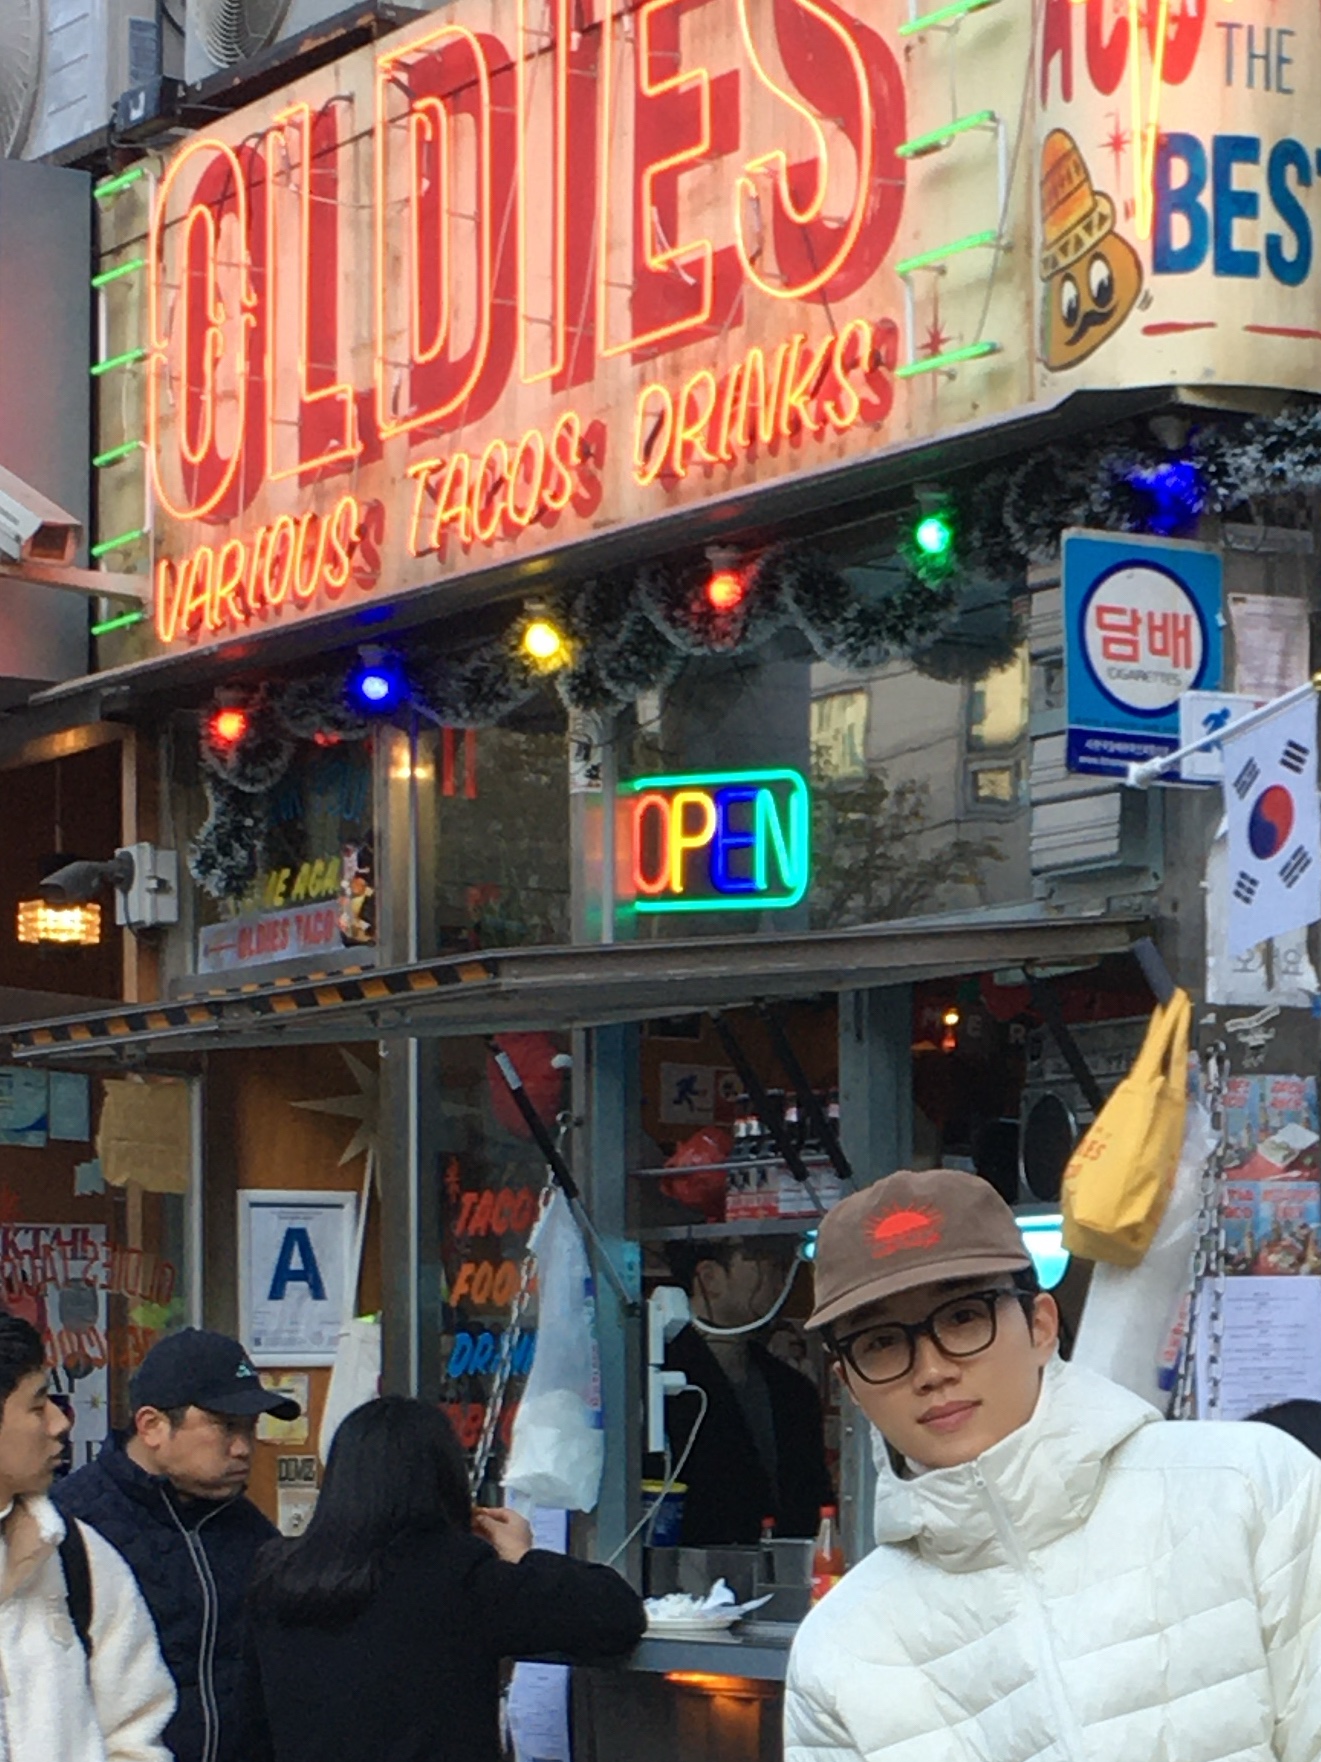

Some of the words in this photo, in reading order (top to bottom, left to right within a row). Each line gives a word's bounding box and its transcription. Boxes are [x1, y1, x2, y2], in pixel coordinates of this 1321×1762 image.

[1215, 22, 1295, 94] THE
[149, 0, 905, 524] OLDIES
[156, 498, 383, 642] VARIOUS
[409, 413, 603, 558] TACOS
[635, 320, 896, 488] DRINKS
[1095, 604, 1193, 669] 담배
[632, 787, 800, 894] OPEN
[267, 1226, 328, 1301] A
